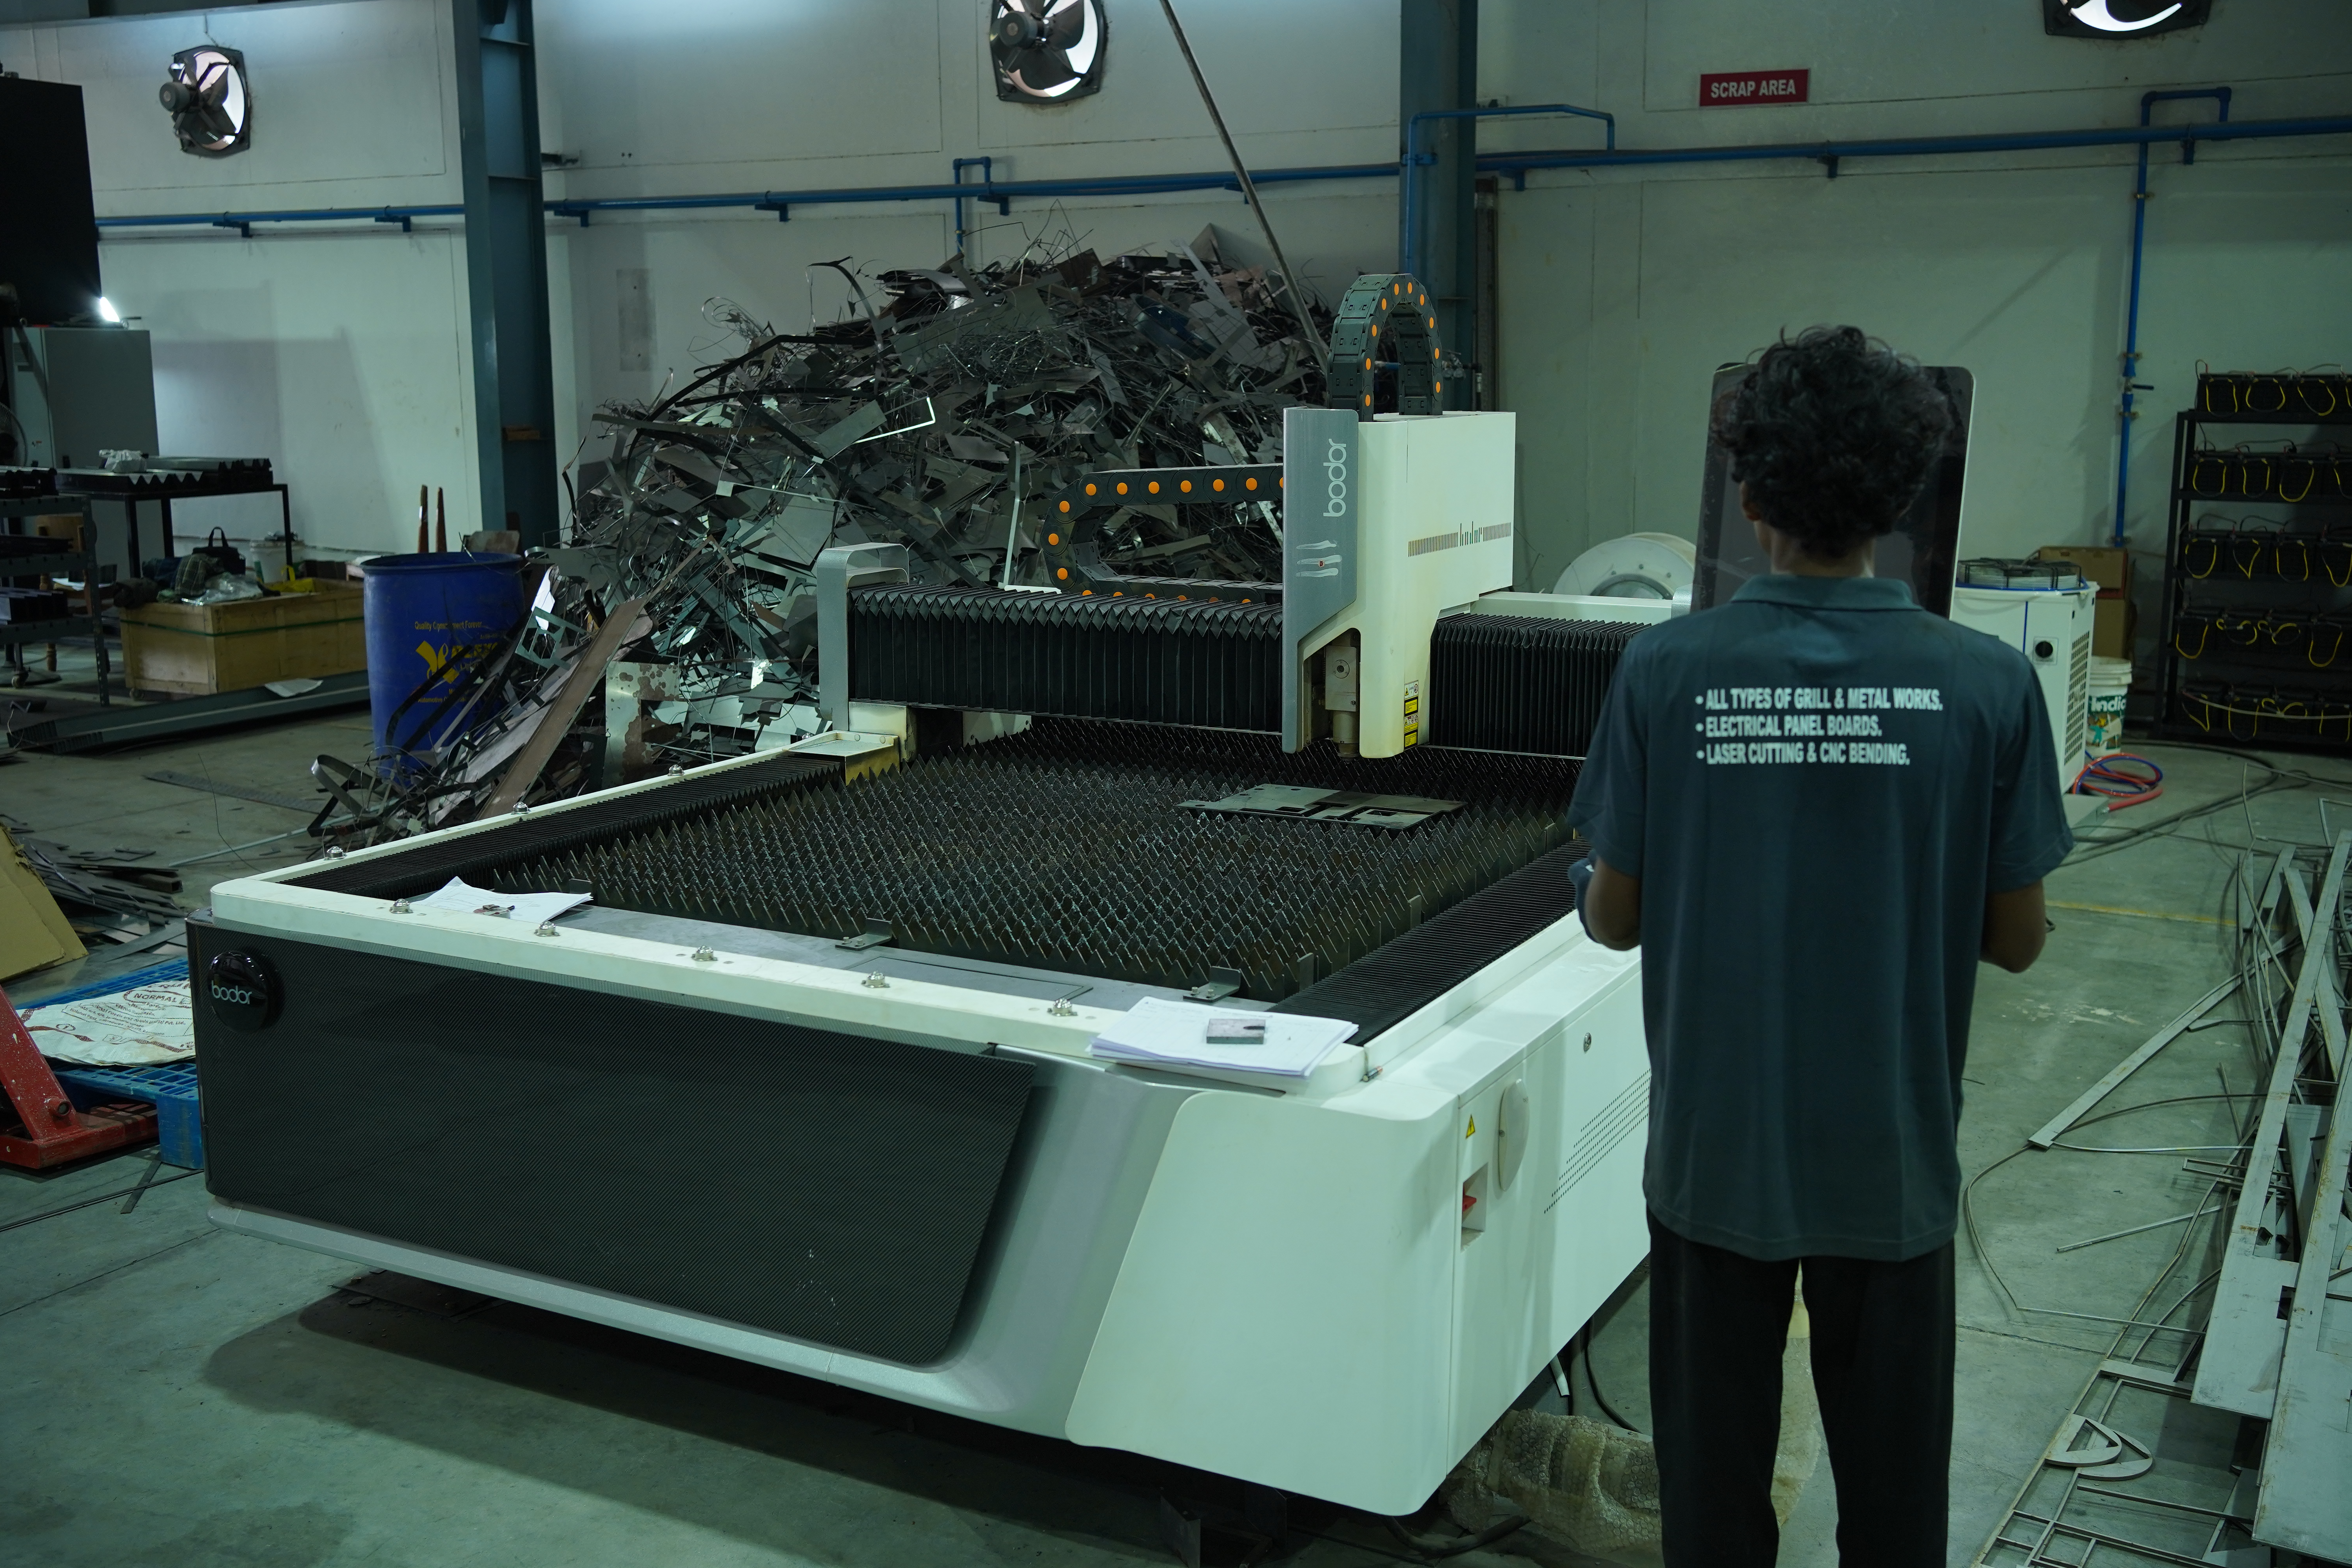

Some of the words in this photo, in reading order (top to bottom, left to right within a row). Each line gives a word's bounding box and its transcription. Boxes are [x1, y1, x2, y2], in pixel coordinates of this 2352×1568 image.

[1711, 81, 1755, 98] SCRAP
[1759, 79, 1796, 96] AREA
[1323, 438, 1347, 517] bodor
[1705, 688, 1729, 710] ALL
[1730, 688, 1772, 709] TYPES
[1774, 688, 1792, 709] OF
[1794, 688, 1831, 709] GRILL
[1834, 688, 1844, 709] &
[1847, 688, 1891, 709] METAL
[1893, 688, 1943, 711] WORKS.
[1706, 716, 1782, 737] ELECTRICAL
[1784, 715, 1825, 736] PANEL
[1827, 715, 1882, 737] BOARDS.
[1706, 743, 1747, 765] LASER
[1748, 742, 1804, 764] CUTTING
[1806, 742, 1817, 763] &
[1820, 742, 1846, 764] CNC
[1849, 743, 1910, 765] BENDING.
[134, 993, 177, 1002] NORMAL
[212, 980, 252, 1004] bodor
